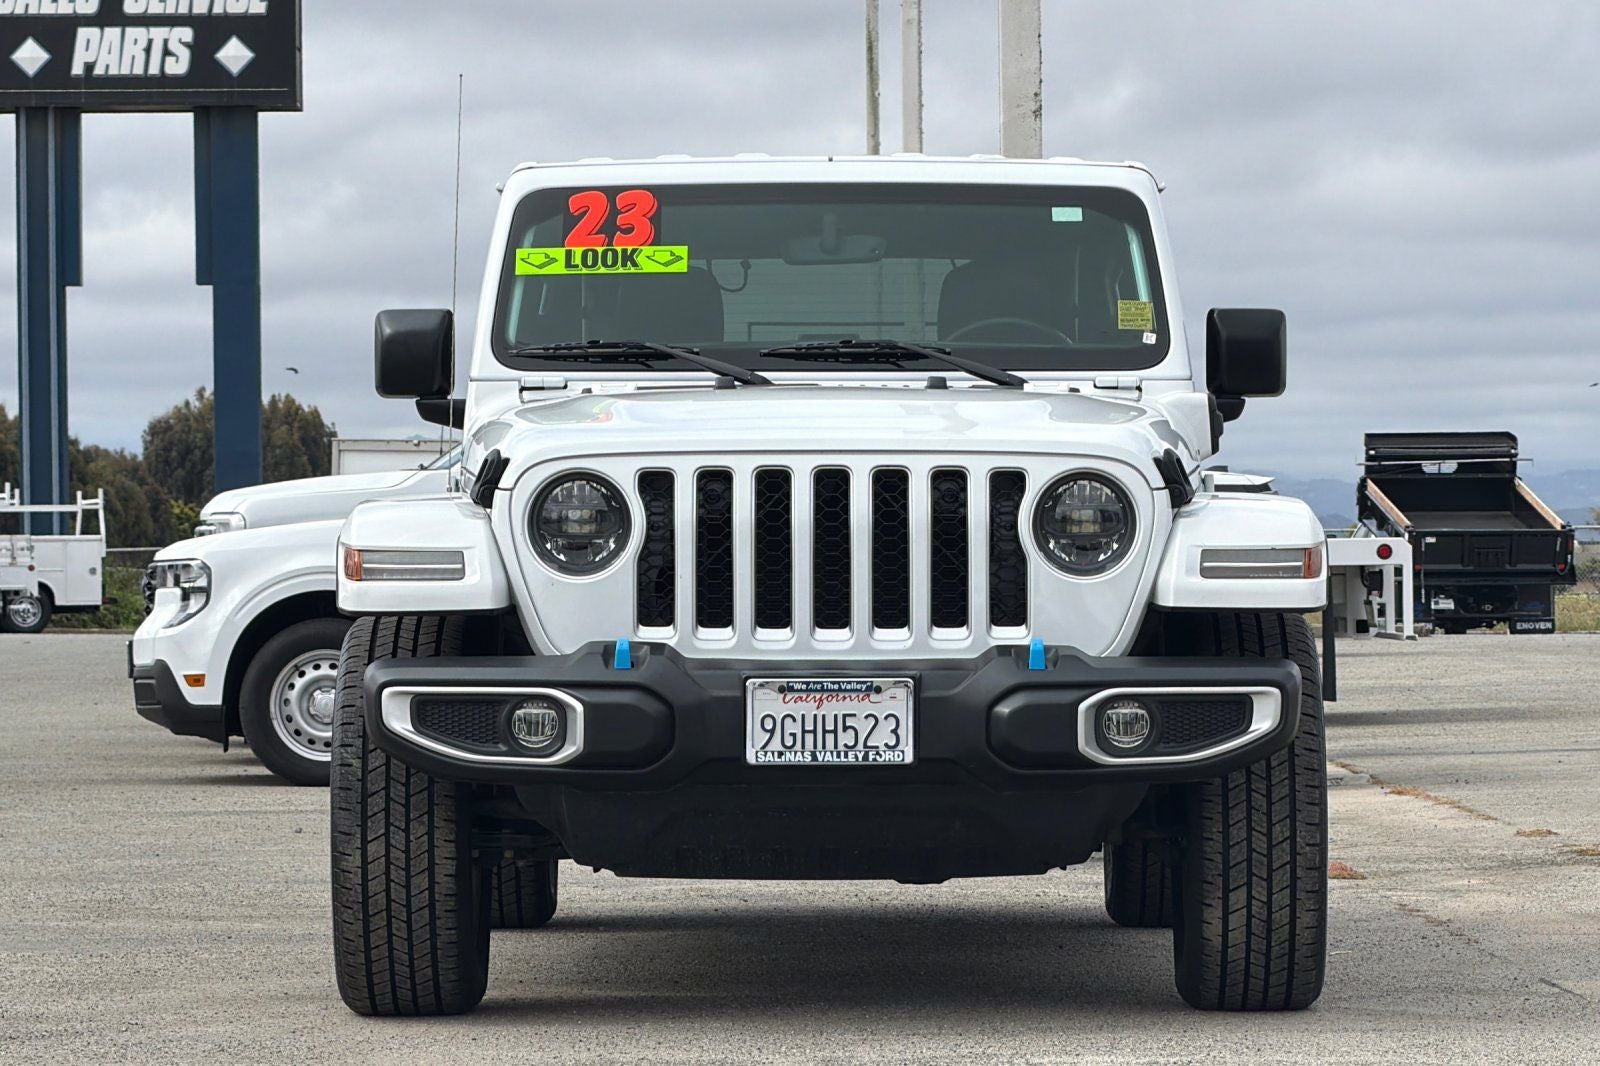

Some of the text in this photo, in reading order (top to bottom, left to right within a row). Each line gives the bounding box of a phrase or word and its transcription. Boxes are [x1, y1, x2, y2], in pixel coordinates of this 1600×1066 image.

[71, 26, 194, 78] PARTS
[564, 190, 658, 247] 23
[564, 247, 644, 271] LOOK
[809, 682, 822, 690] Are
[823, 682, 839, 690] The
[782, 692, 882, 710] California
[759, 713, 901, 750] 9GHH523
[757, 751, 904, 762] SALINAS VALLEY FORD
